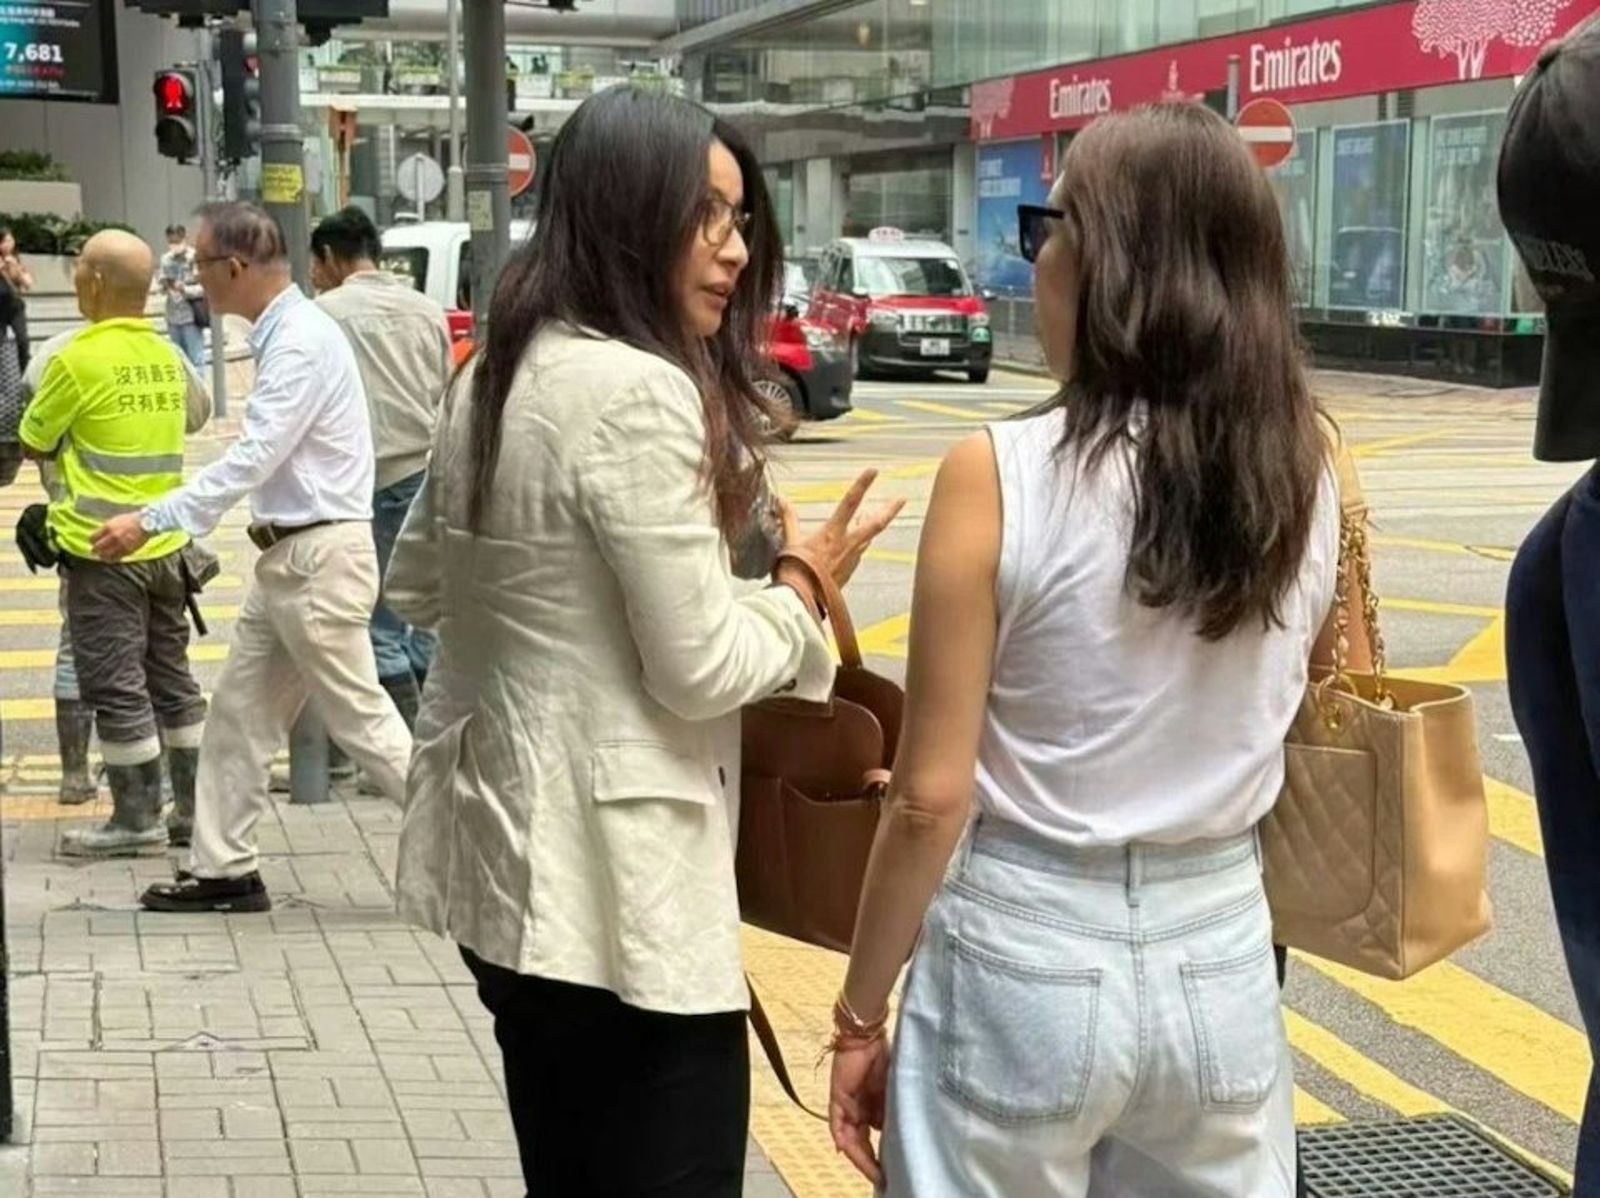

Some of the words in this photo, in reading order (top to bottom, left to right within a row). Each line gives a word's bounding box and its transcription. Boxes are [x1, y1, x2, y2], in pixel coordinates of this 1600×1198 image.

[1250, 36, 1342, 92] Emirates
[1049, 74, 1112, 119] Emirates
[118, 391, 186, 413] 只有更安
